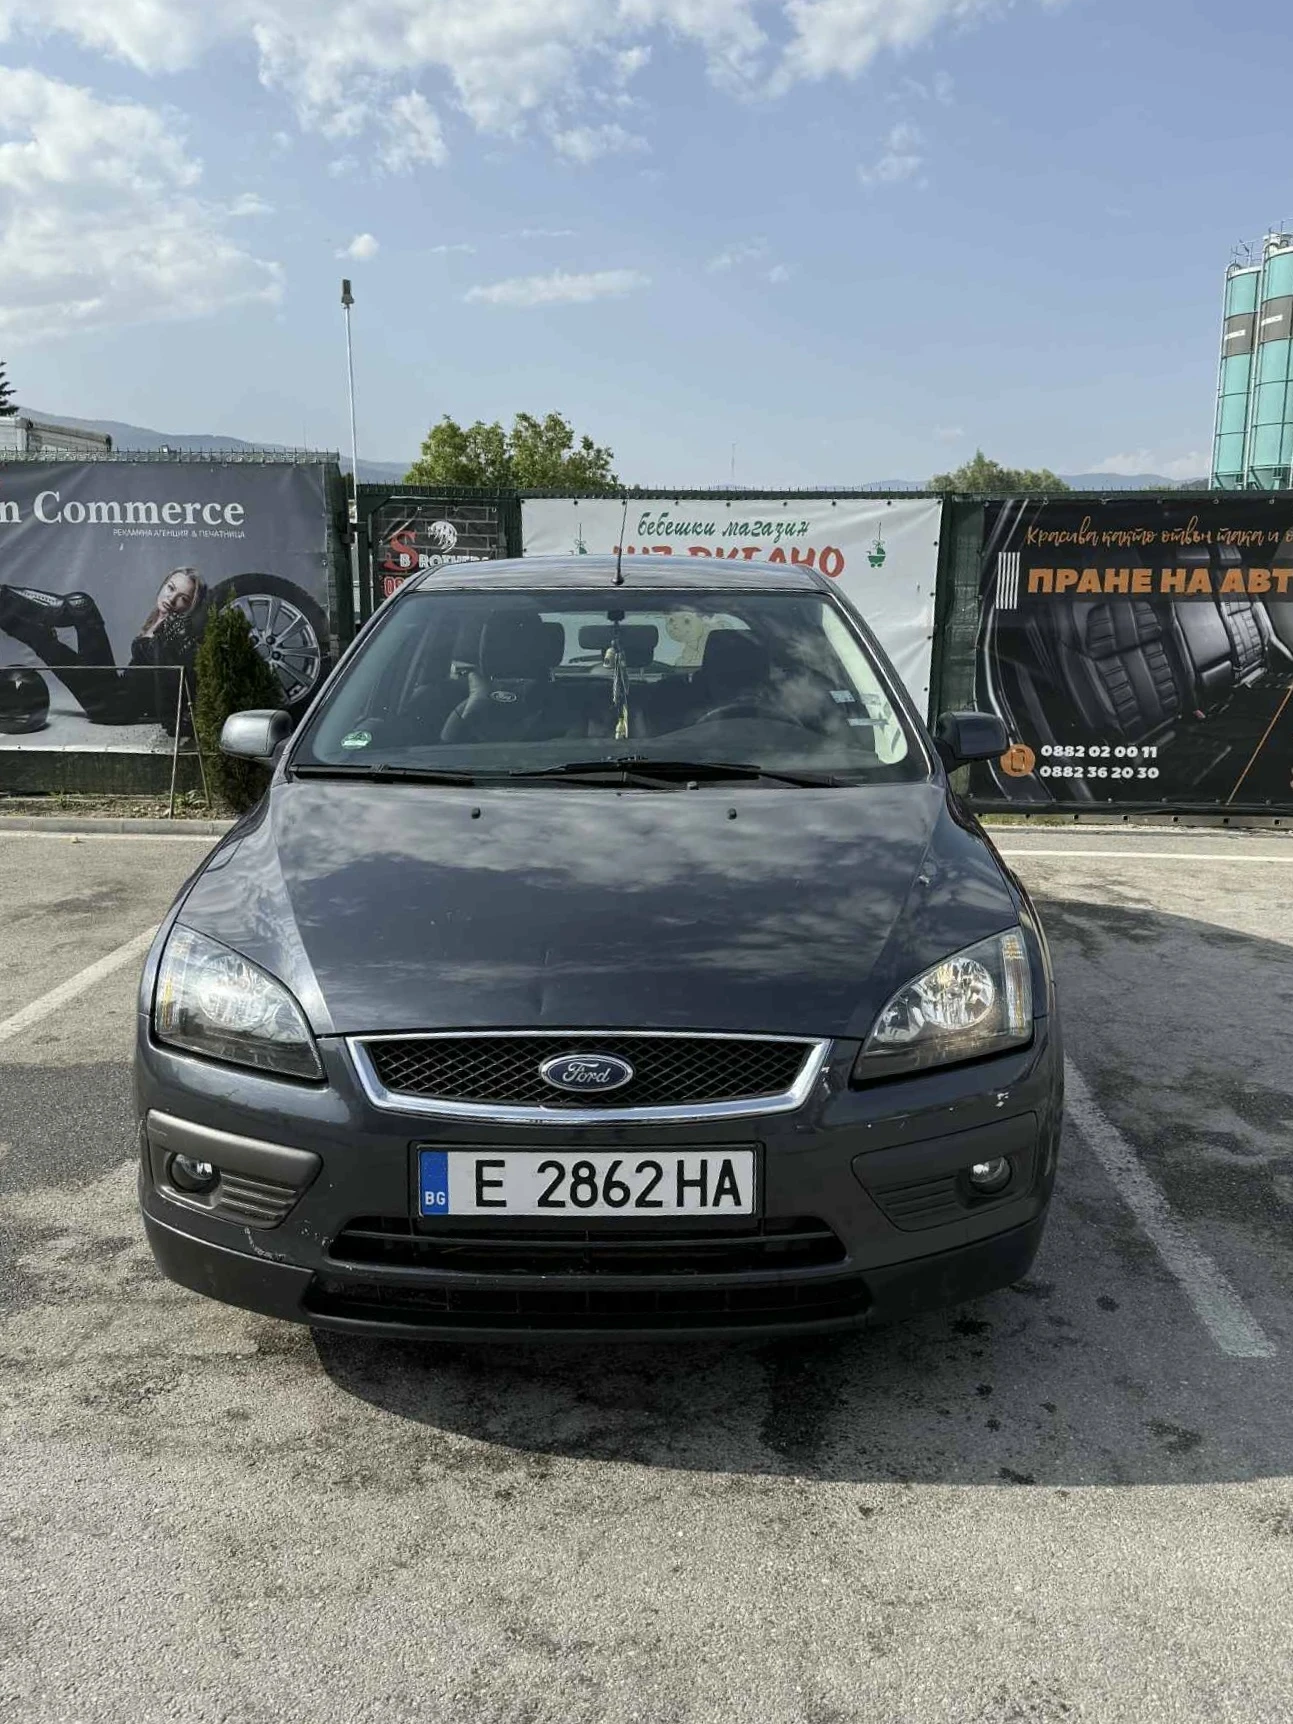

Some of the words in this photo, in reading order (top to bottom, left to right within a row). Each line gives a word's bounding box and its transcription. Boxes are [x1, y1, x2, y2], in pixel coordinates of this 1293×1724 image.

[34, 490, 245, 525] Commerce
[113, 528, 152, 537] РЕКЛАМНА
[154, 529, 188, 538] АГЕНЦИЯ
[199, 529, 245, 539] ПЕЧАТНИЦА
[637, 511, 717, 537] бебешки
[722, 519, 810, 544] магазин
[1026, 515, 1099, 547] Красива
[1101, 527, 1158, 548] както
[1161, 515, 1213, 546] отвън
[1216, 527, 1265, 548] така
[1268, 527, 1279, 543] и
[1027, 567, 1152, 594] ПРАНЕ
[1160, 567, 1213, 594] НА
[1219, 567, 1293, 594] АВТ
[1040, 744, 1086, 758] 0882
[1088, 745, 1111, 758] 02
[1114, 745, 1139, 758] 00
[1141, 745, 1158, 759] 11
[1039, 765, 1084, 778] 0882
[1087, 766, 1108, 779] 36
[1111, 766, 1134, 779] 20
[1136, 766, 1160, 779] 30
[561, 1061, 612, 1083] Ford
[474, 1159, 507, 1208] E
[424, 1191, 447, 1206] BG
